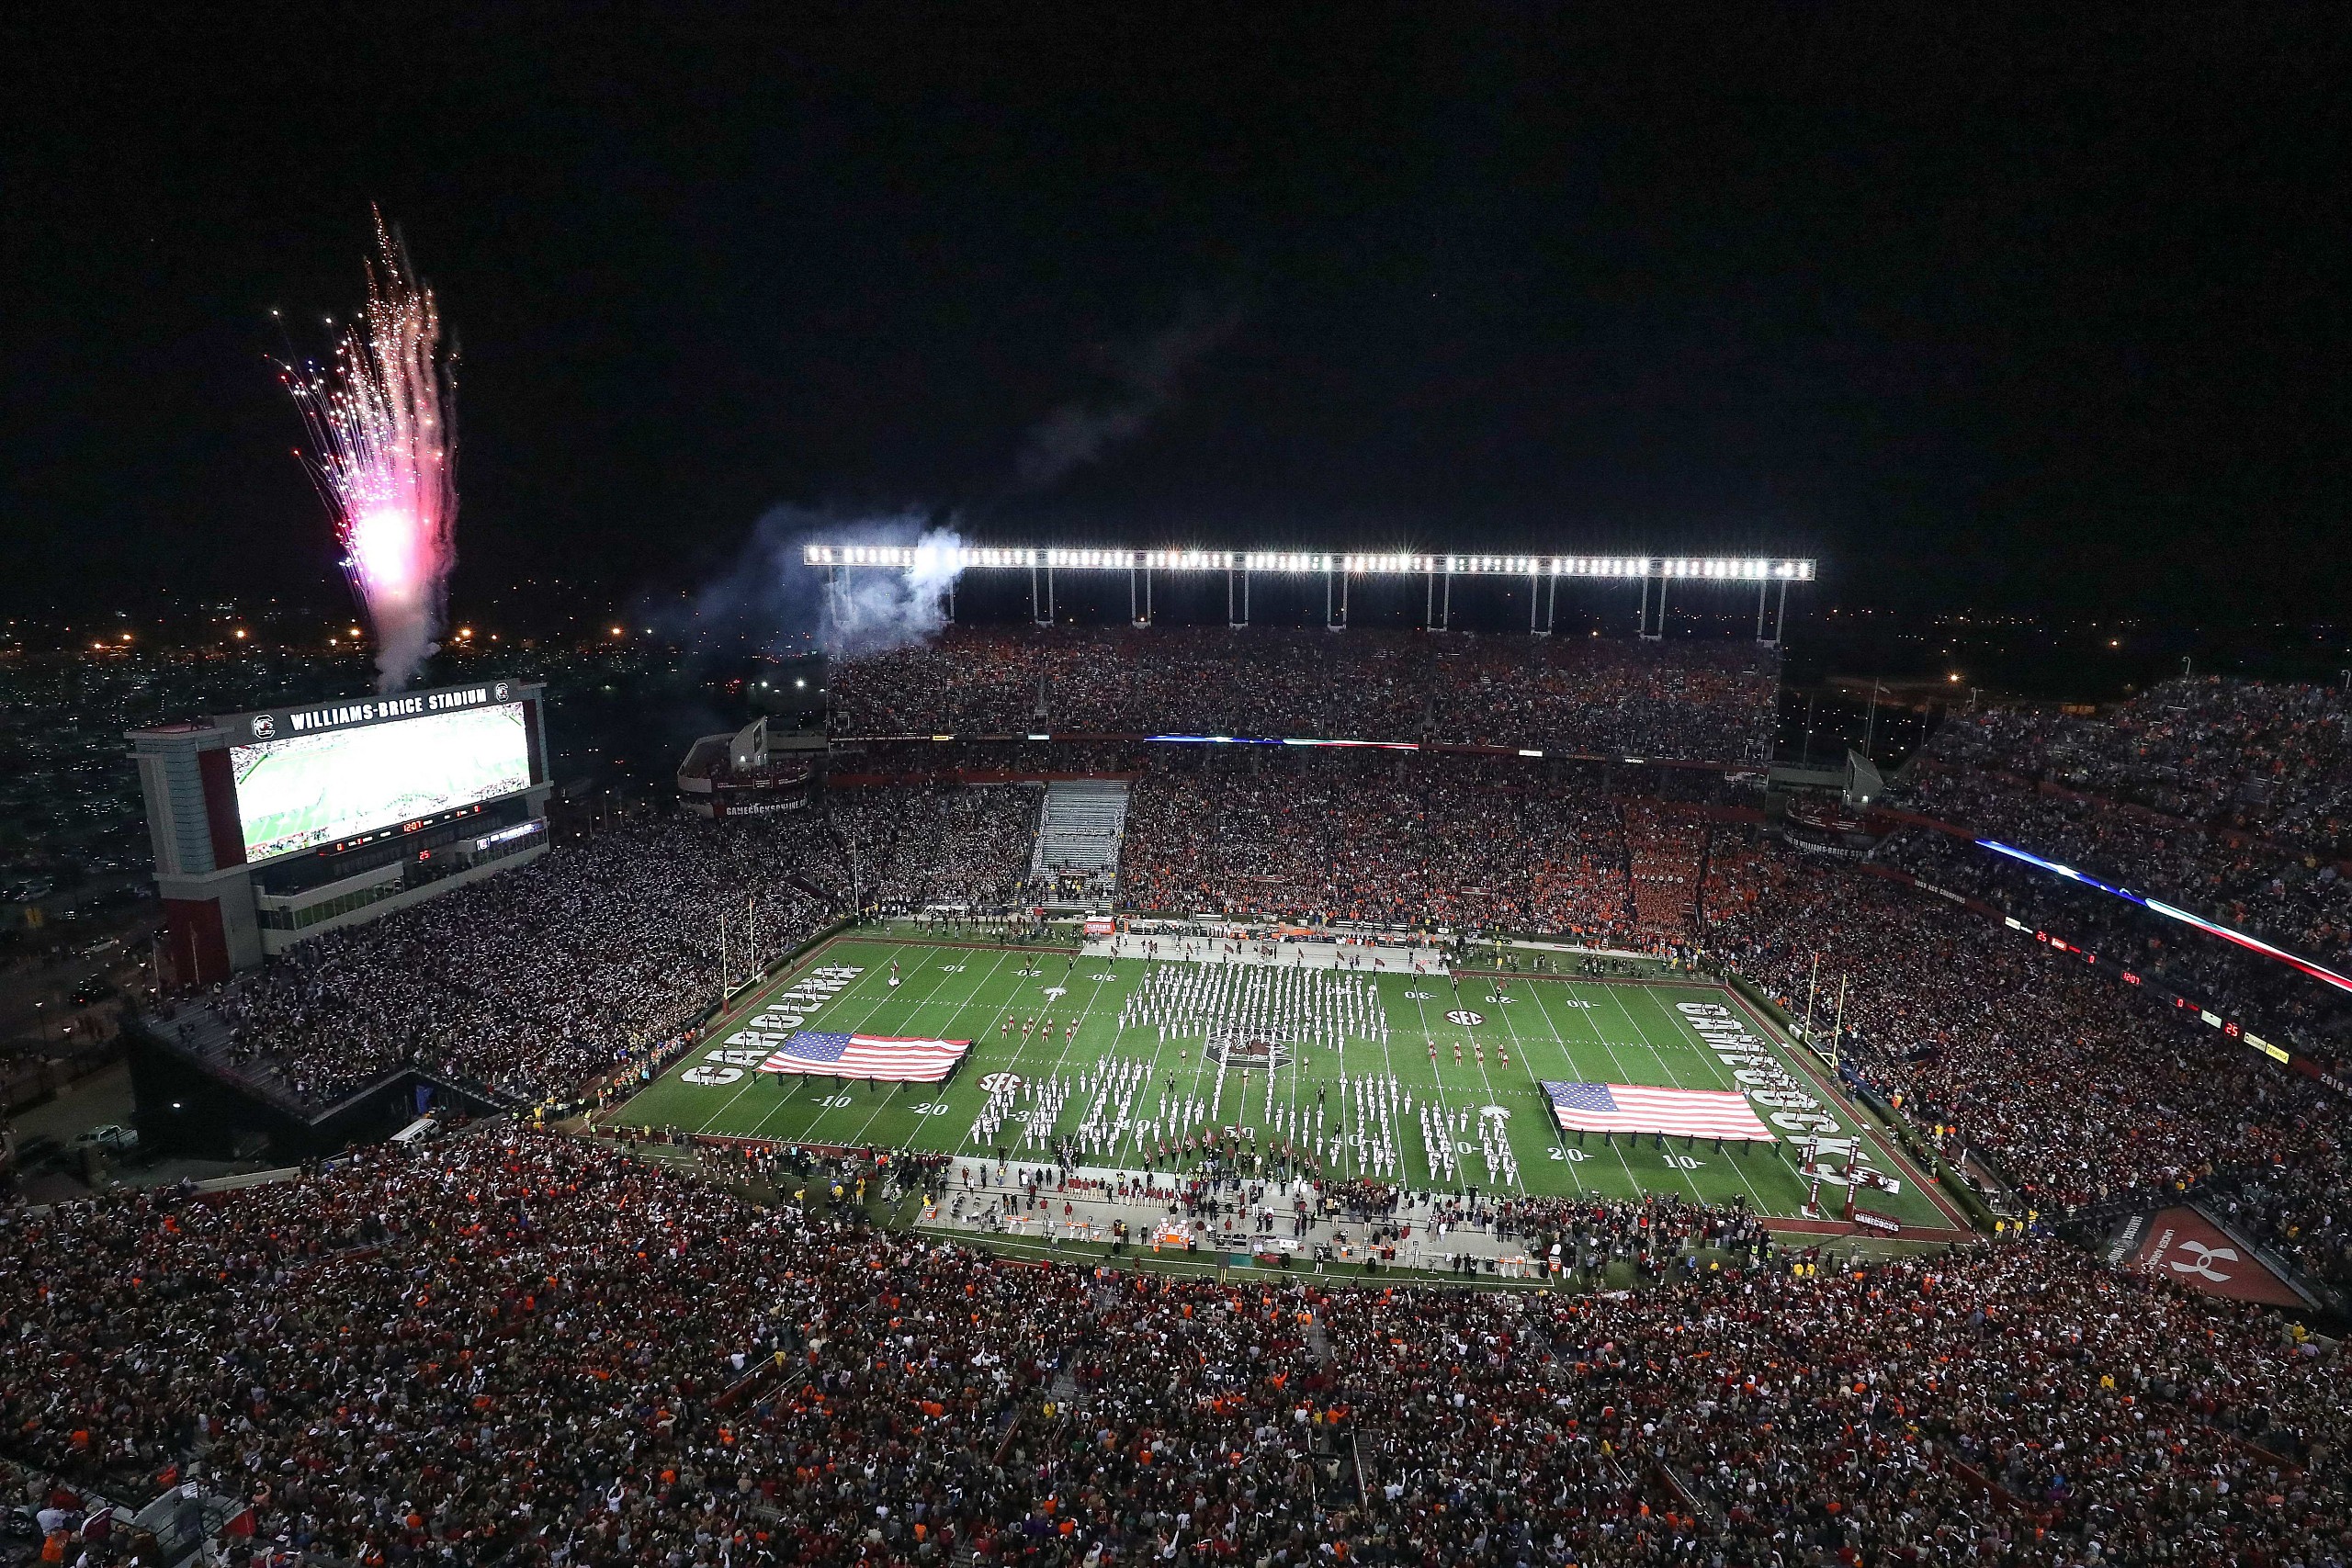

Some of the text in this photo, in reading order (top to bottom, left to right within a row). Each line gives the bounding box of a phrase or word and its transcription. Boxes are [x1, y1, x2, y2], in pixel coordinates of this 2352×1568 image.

[290, 688, 487, 731] WILLIAMS-BRICE STADIUM
[403, 820, 422, 832] 12:07
[419, 850, 430, 860] 25
[2037, 931, 2047, 942] 25
[1091, 974, 1117, 982] 30
[2122, 972, 2140, 986] 12:07
[2178, 998, 2184, 1008] 0
[1446, 1010, 1484, 1026] SEC
[680, 966, 865, 1085] CAROLINA
[2225, 1022, 2238, 1037] 25
[979, 1072, 1022, 1092] SEC
[820, 1095, 853, 1108] 10
[913, 1102, 950, 1116] 20
[1547, 1147, 1585, 1162] 20
[1662, 1155, 1699, 1169] 10
[1855, 1213, 1900, 1232] GAMECOCKS
[2156, 1228, 2177, 1249] UNDER
